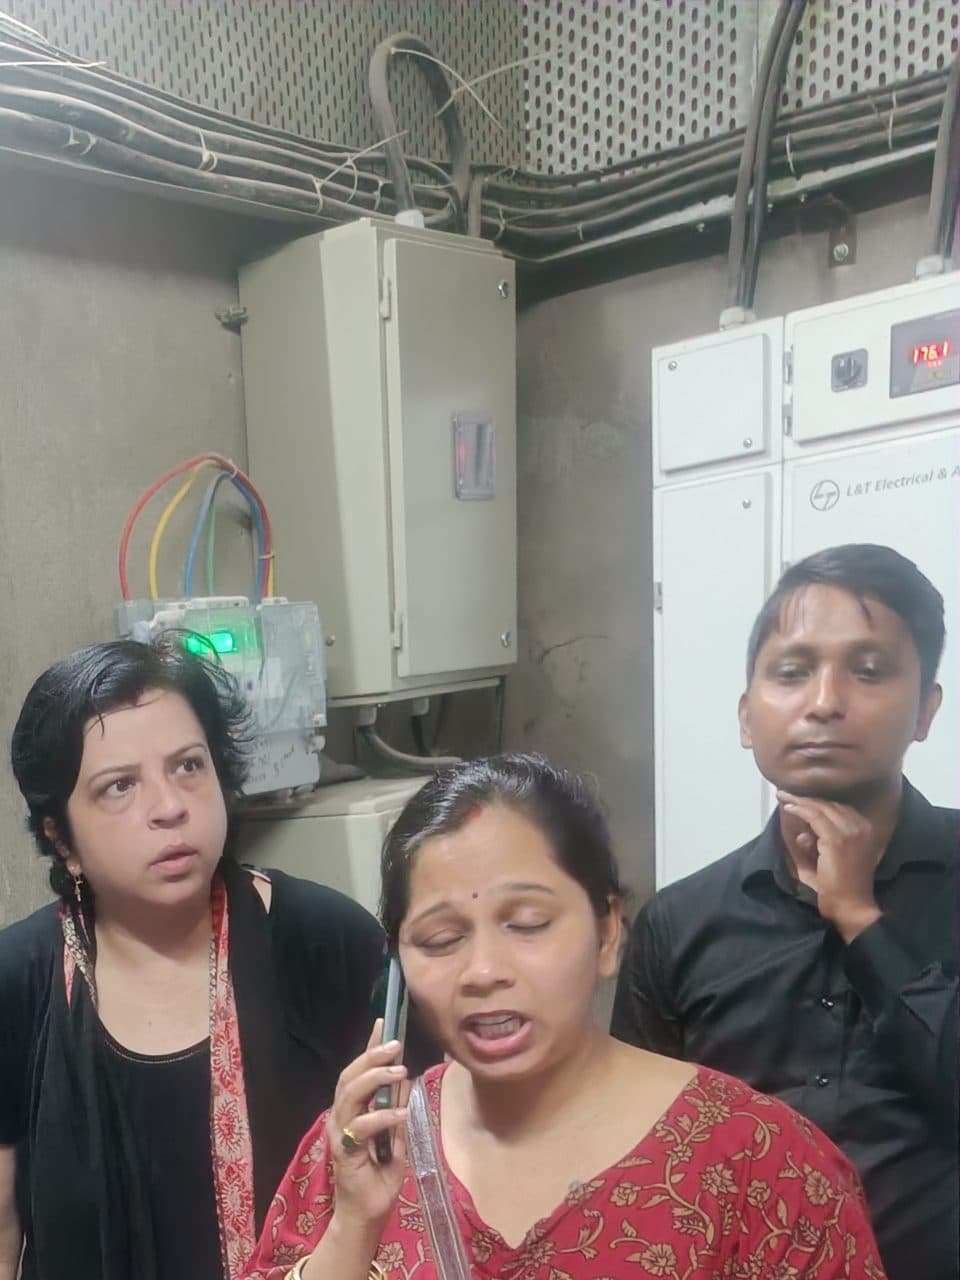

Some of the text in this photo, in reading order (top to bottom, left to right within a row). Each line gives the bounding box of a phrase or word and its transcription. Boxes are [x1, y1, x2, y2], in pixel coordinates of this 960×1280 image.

[847, 482, 872, 497] L&T
[874, 469, 934, 492] Electrical
[937, 467, 948, 480] &
